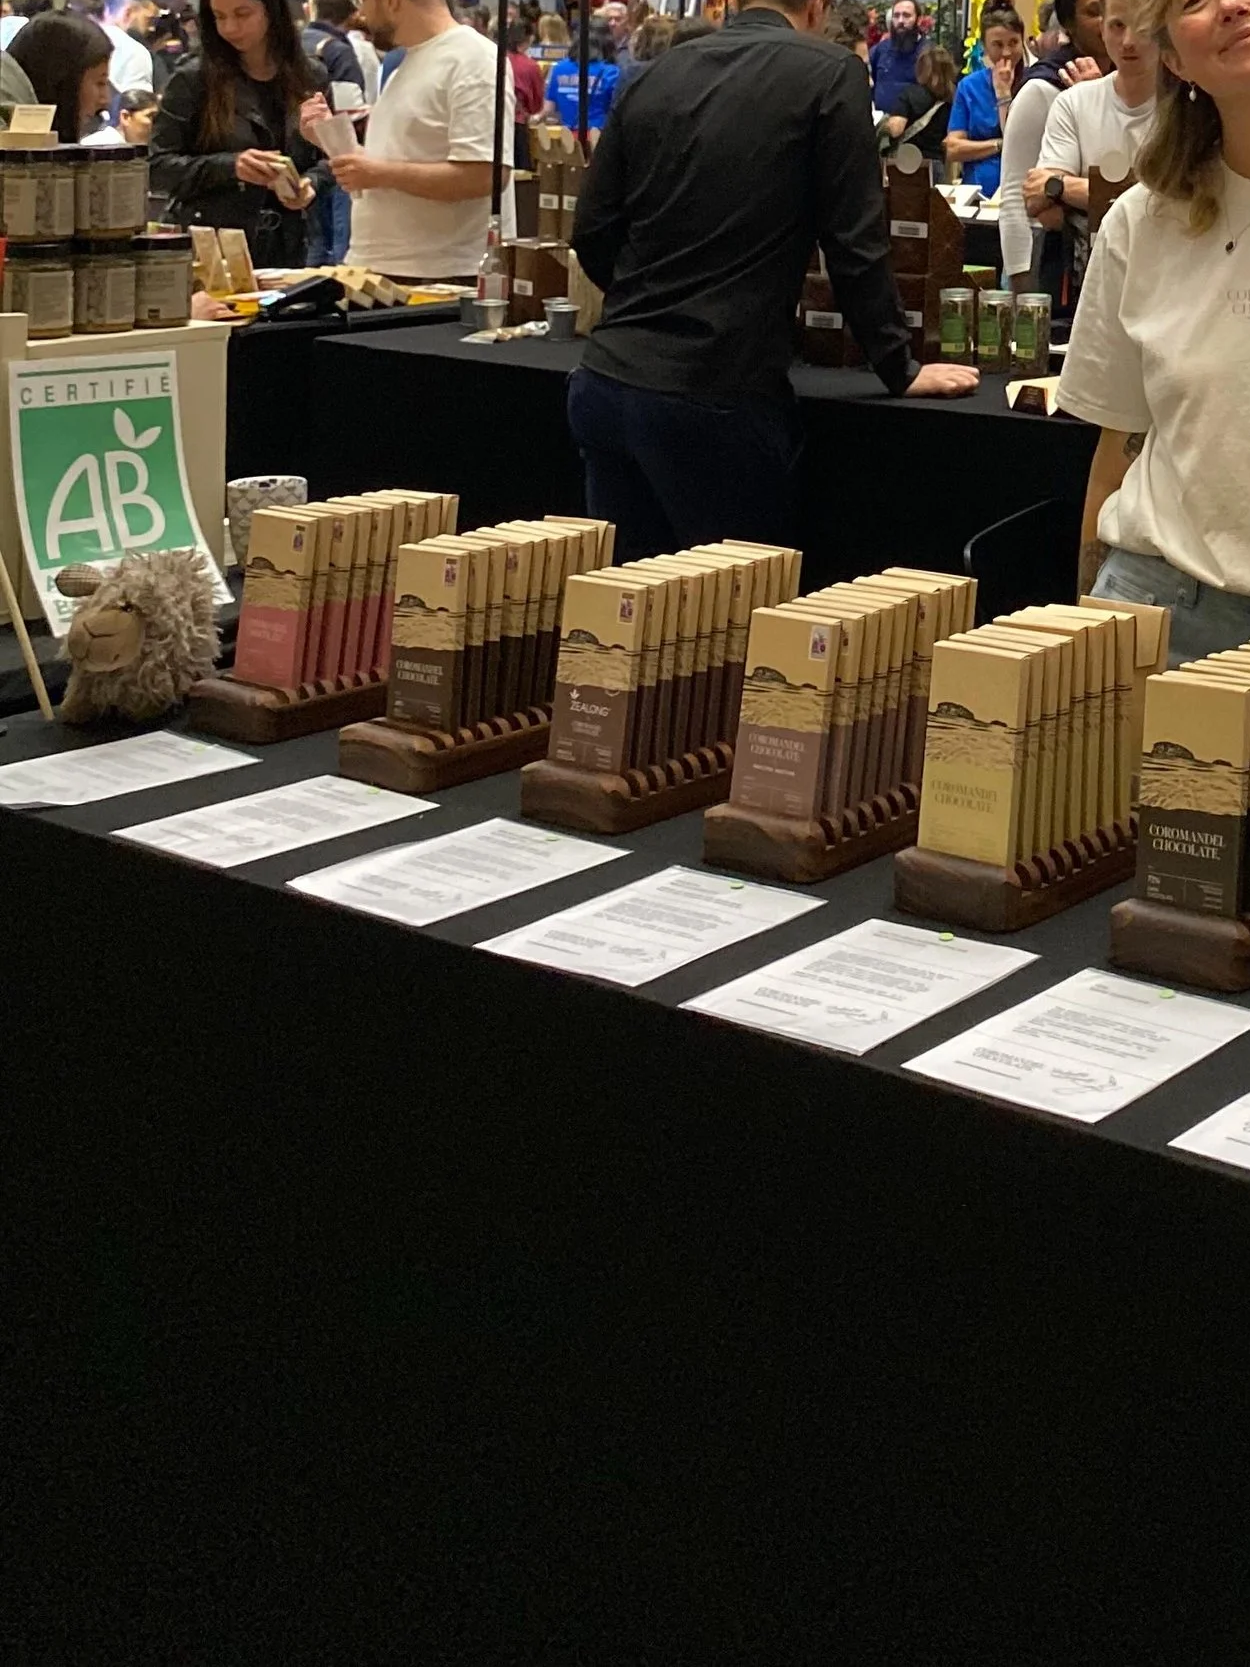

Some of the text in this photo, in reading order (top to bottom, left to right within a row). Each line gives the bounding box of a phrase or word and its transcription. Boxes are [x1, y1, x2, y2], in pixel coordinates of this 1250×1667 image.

[19, 373, 171, 406] CERTIFIÉ
[45, 450, 166, 560] AB
[1149, 823, 1226, 848] COROMANDEL
